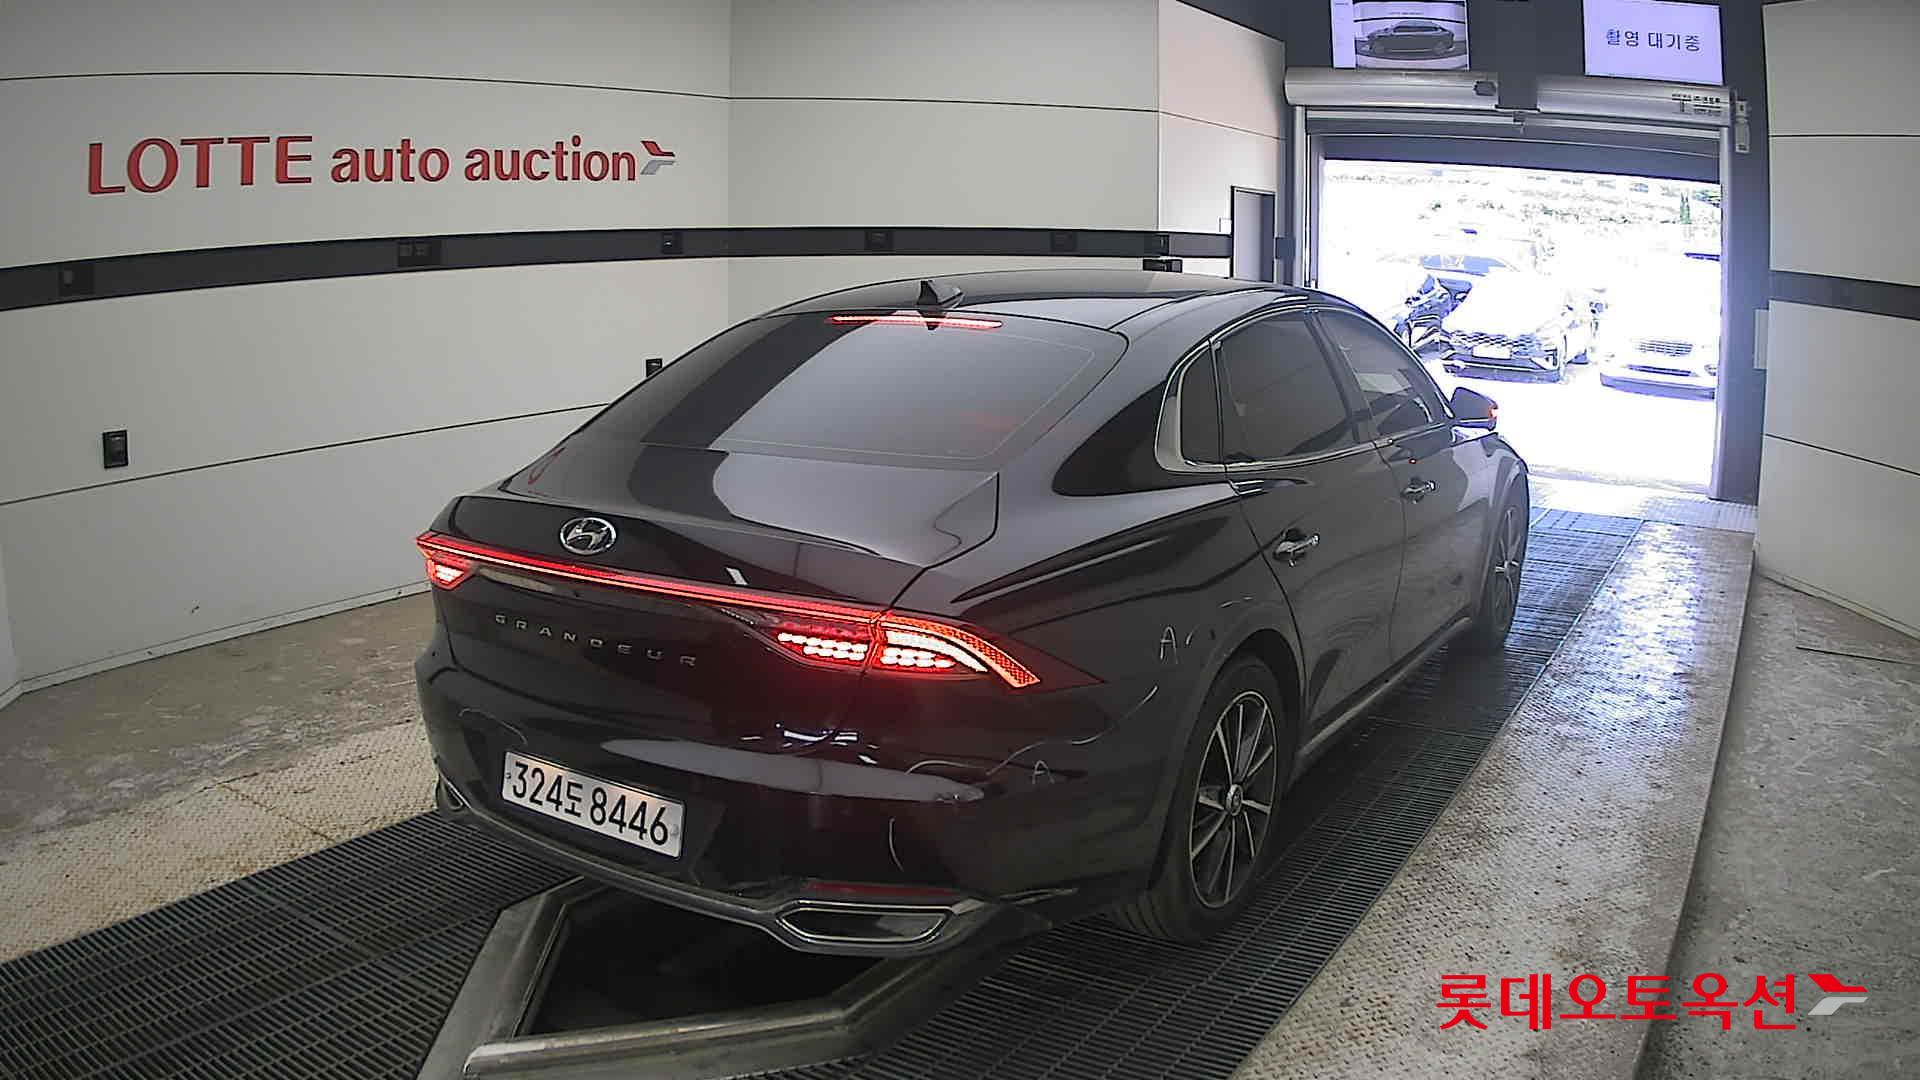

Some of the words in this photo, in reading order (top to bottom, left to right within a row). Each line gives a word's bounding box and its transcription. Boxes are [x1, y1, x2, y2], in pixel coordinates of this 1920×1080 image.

[1606, 29, 1639, 47] 촬영
[1648, 32, 1700, 52] 대기중
[88, 135, 313, 195] LOTTE
[330, 138, 450, 184] auto
[464, 135, 637, 183] auction
[495, 615, 697, 667] GRANDEUR
